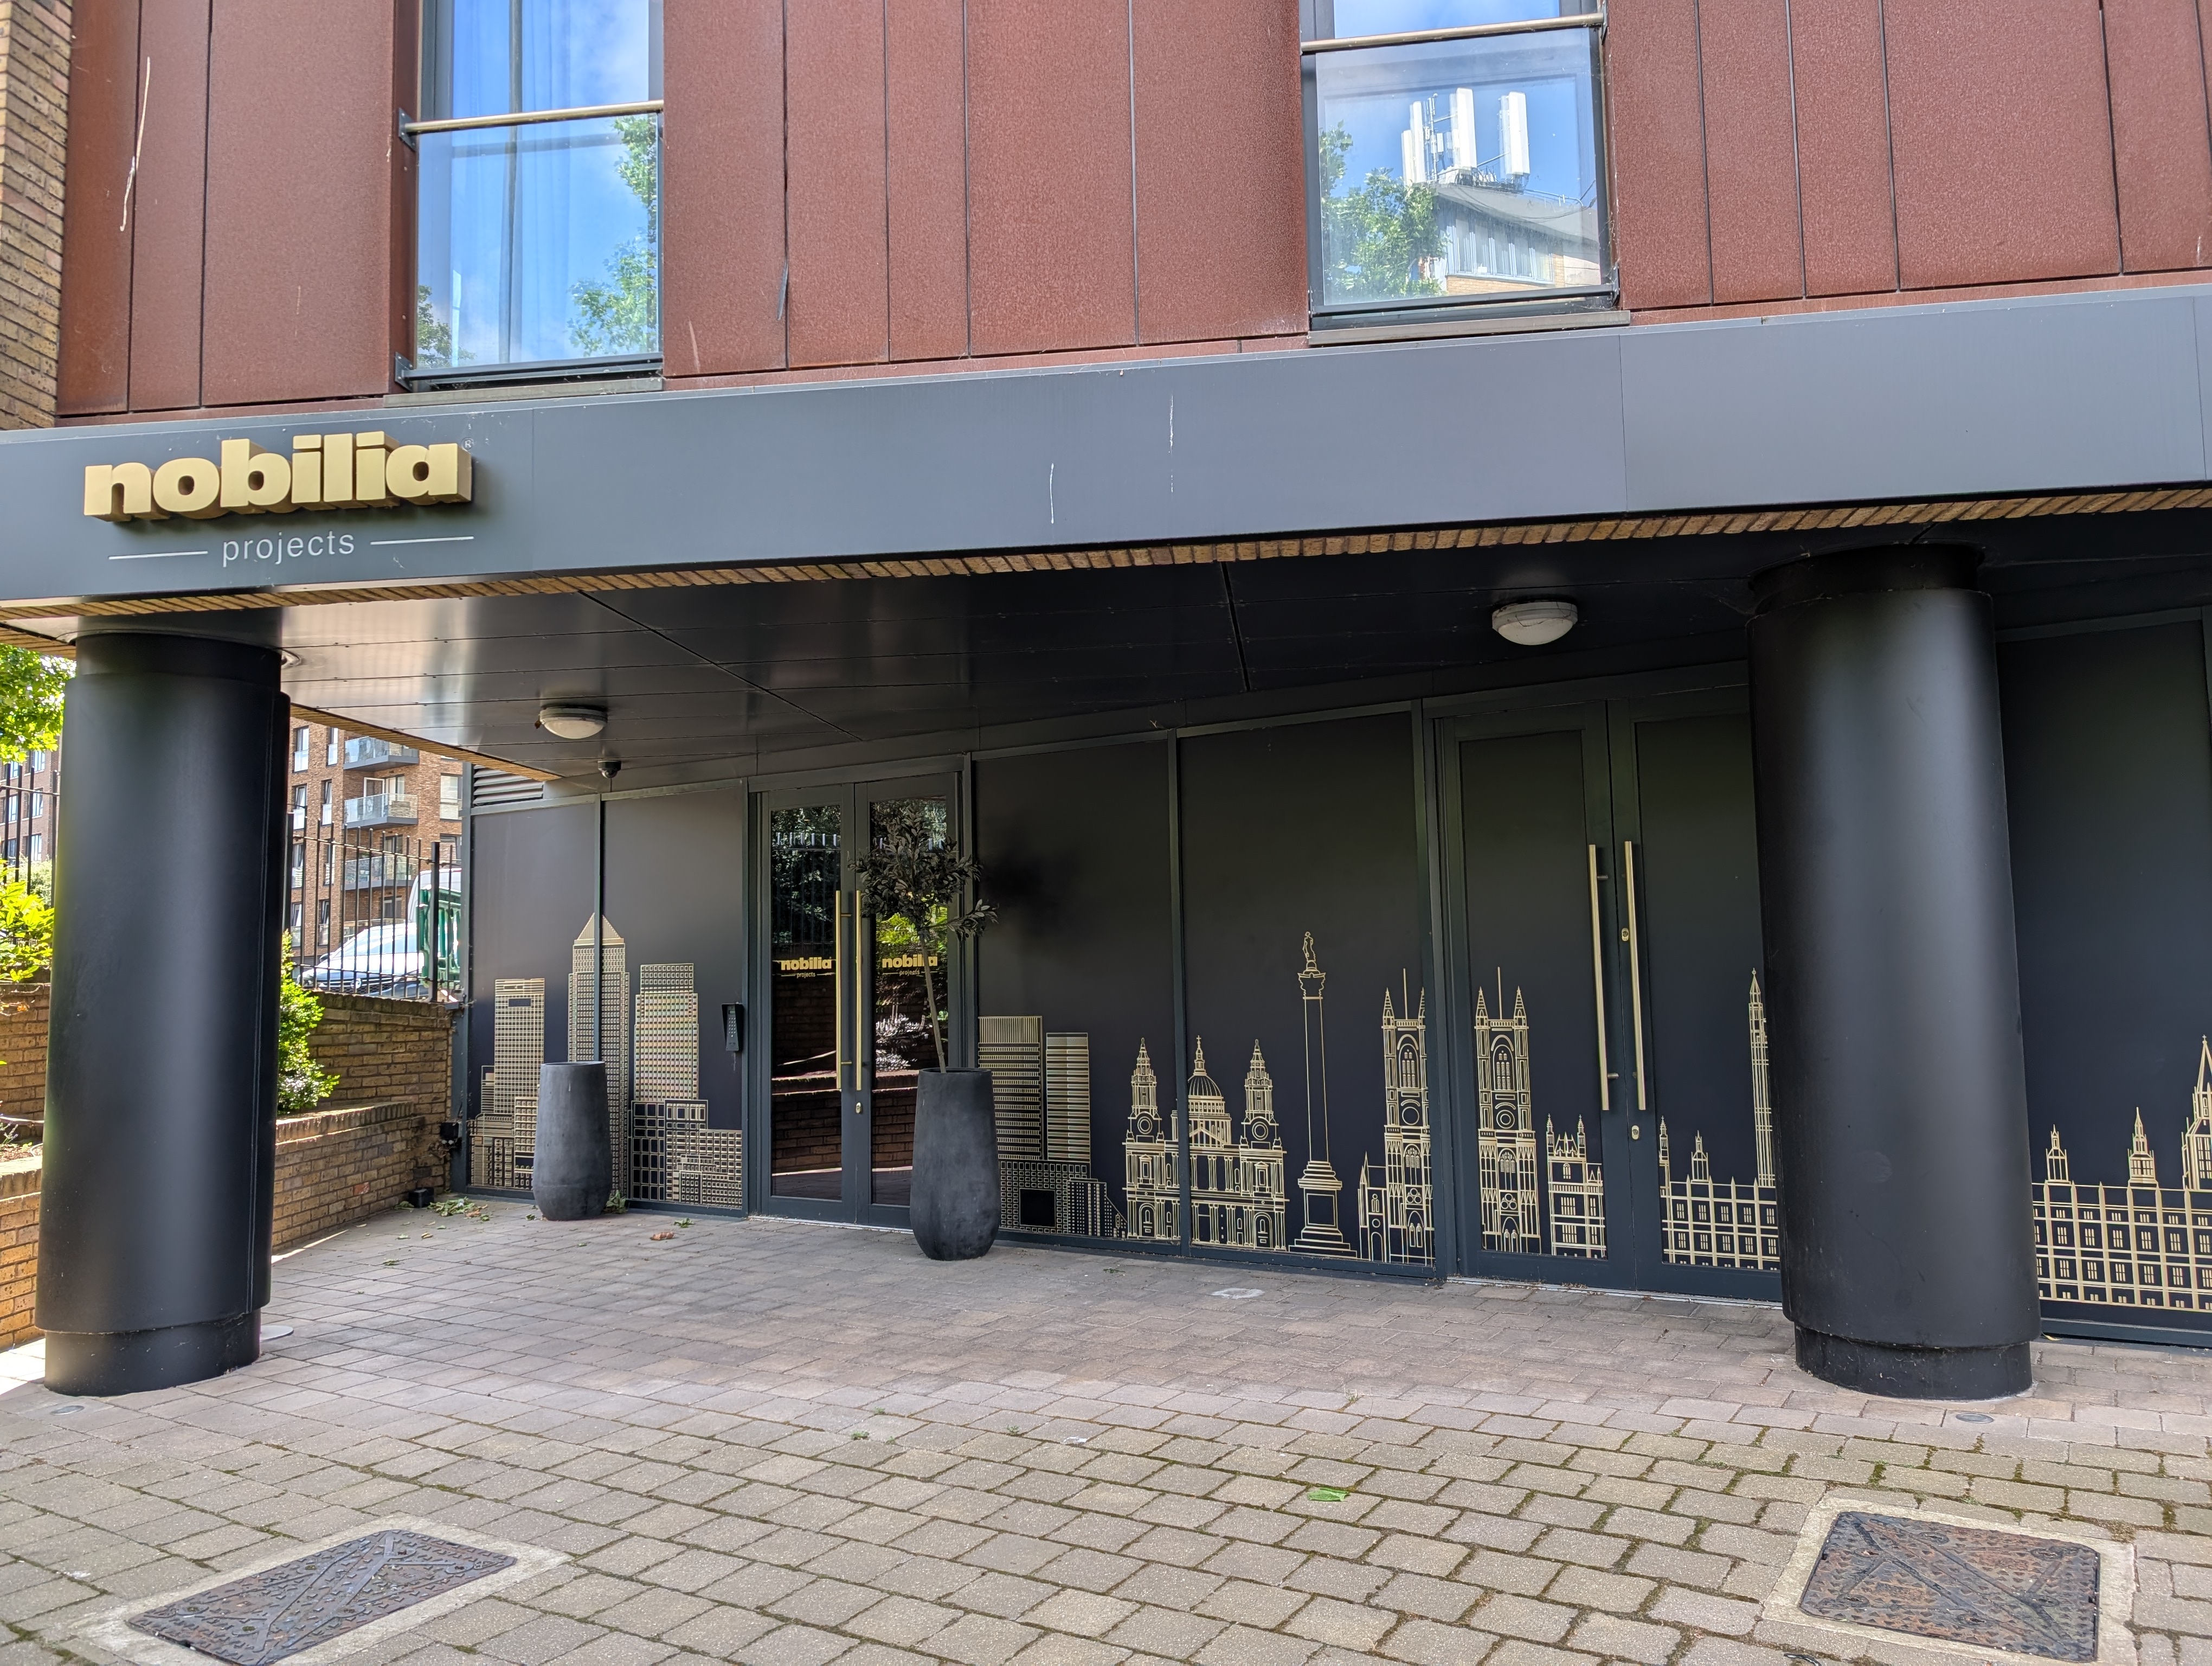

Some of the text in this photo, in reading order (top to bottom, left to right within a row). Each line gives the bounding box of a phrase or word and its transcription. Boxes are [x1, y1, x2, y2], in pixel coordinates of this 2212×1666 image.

[83, 431, 470, 520] nobilia
[222, 530, 355, 567] projects
[781, 957, 832, 970] nobilia
